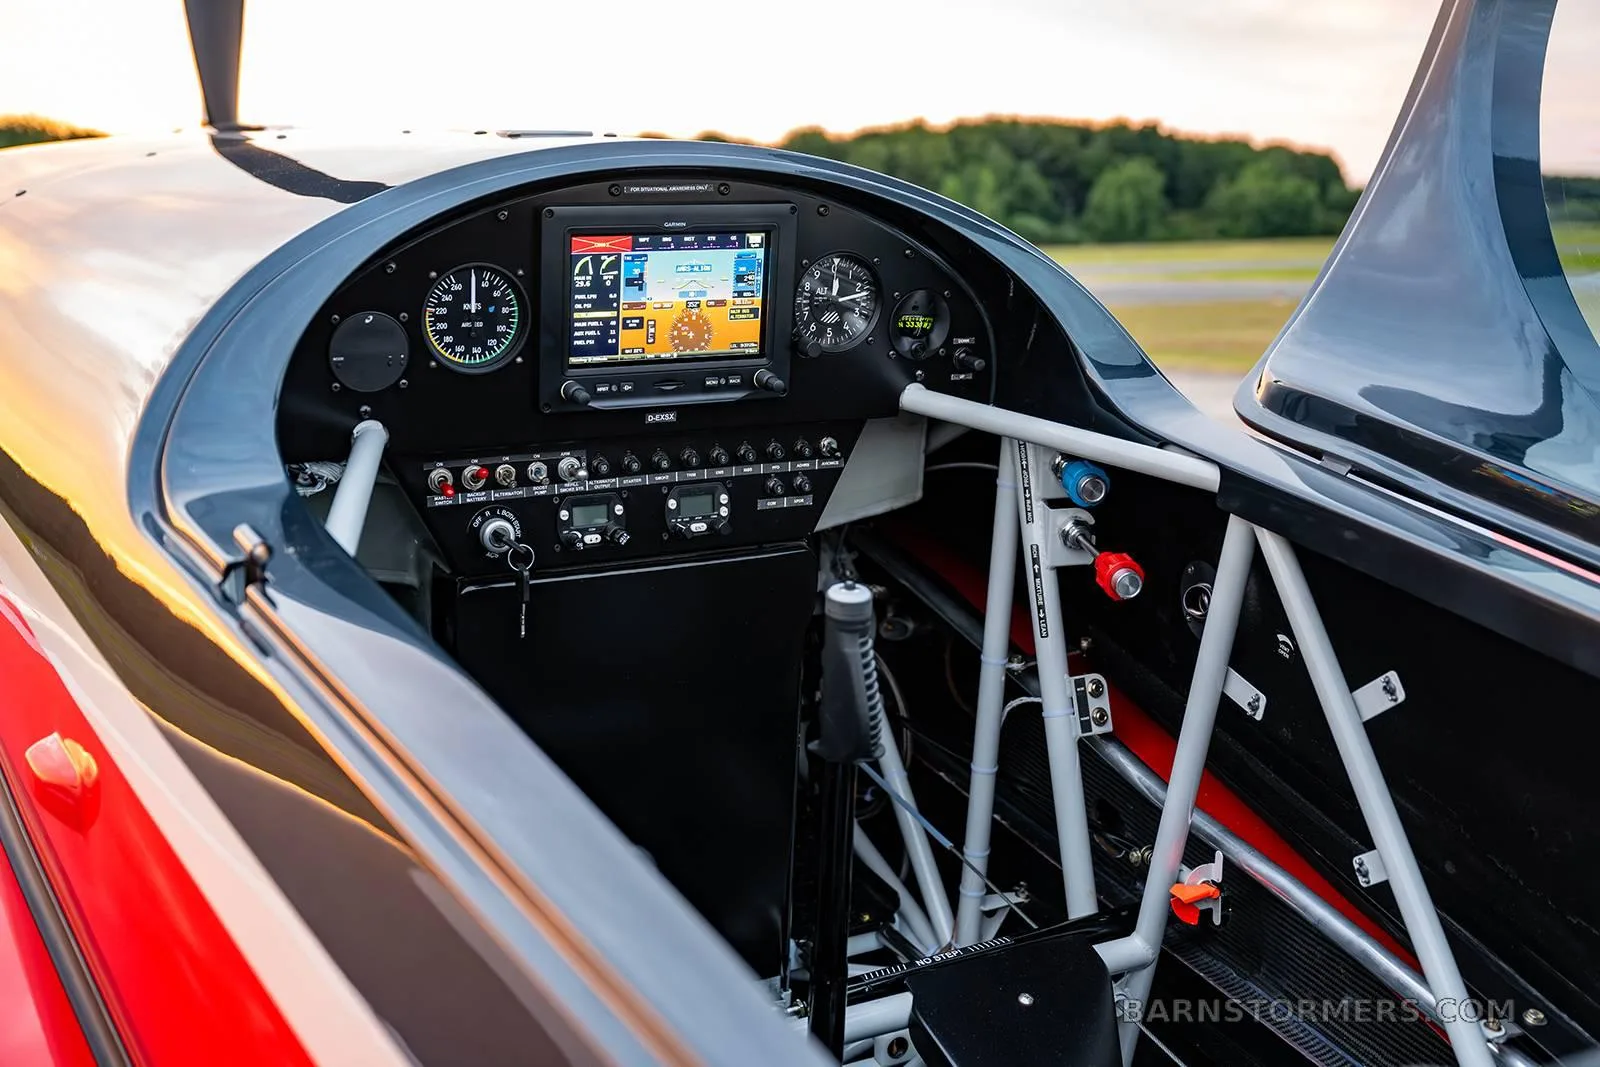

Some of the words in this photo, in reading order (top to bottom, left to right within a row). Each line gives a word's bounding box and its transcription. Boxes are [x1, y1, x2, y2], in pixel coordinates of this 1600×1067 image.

[814, 270, 820, 279] 9
[849, 270, 852, 279] 1
[805, 282, 810, 291] 8
[816, 287, 828, 295] ALT
[856, 283, 862, 292] 2
[803, 312, 808, 320] 7
[854, 308, 859, 317] 3
[810, 322, 816, 332] 6
[843, 322, 849, 330] 4
[827, 328, 833, 337] 5
[648, 413, 674, 422] D-EXSX
[473, 516, 482, 527] OFF
[501, 510, 516, 521] BOTH
[513, 520, 521, 538] START
[1280, 644, 1289, 653] VENT
[1278, 648, 1289, 659] OPEN
[915, 957, 932, 967] NO
[934, 949, 963, 962] STEP!
